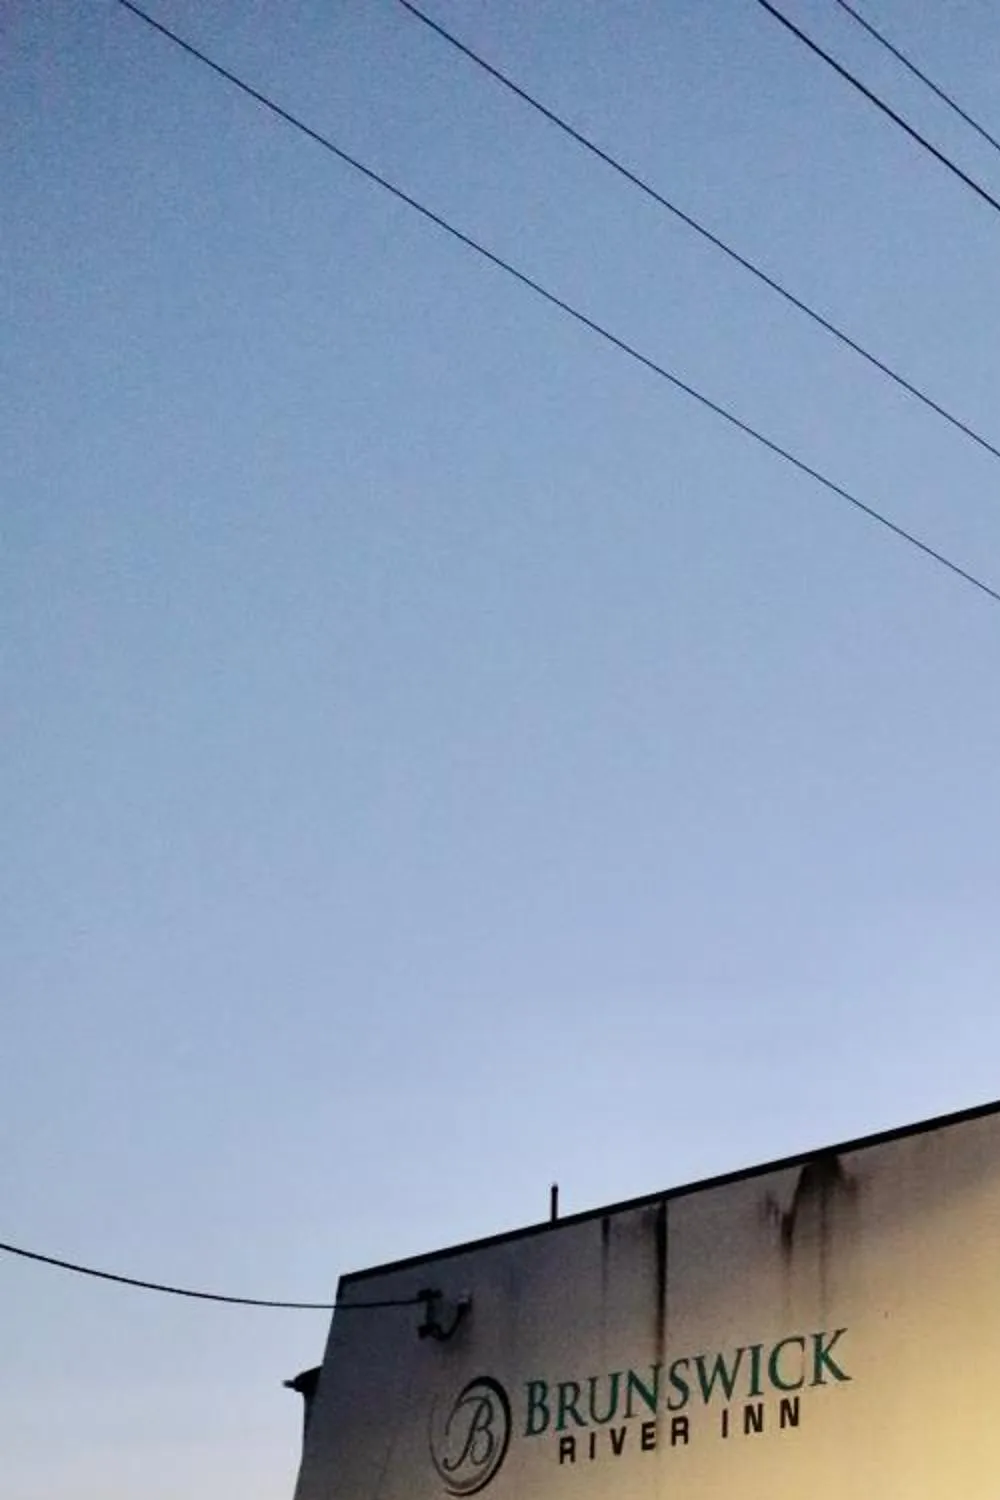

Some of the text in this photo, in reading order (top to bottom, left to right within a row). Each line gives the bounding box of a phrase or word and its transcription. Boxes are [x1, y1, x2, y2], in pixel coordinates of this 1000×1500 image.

[523, 1328, 852, 1436] BRUNSWICK
[558, 1397, 800, 1464] RIVER INN
